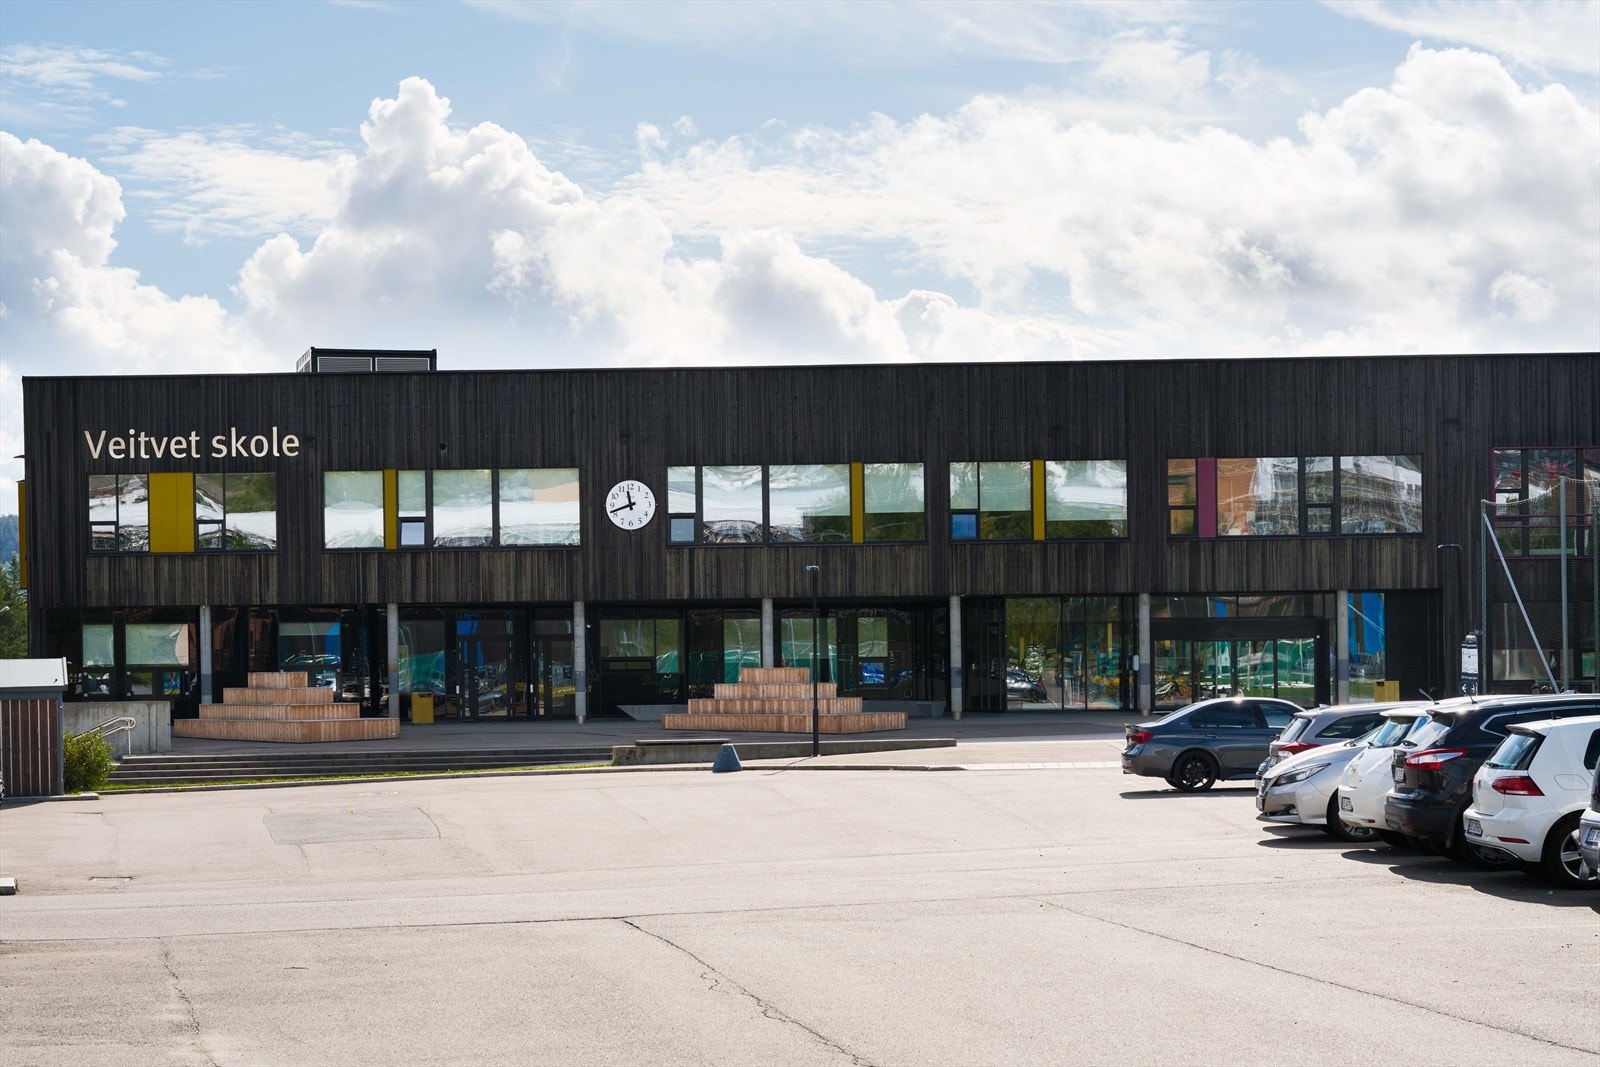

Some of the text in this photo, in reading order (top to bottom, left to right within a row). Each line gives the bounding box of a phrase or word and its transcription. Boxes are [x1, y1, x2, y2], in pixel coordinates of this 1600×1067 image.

[84, 427, 300, 459] Veitvet skole
[611, 492, 619, 500] 10
